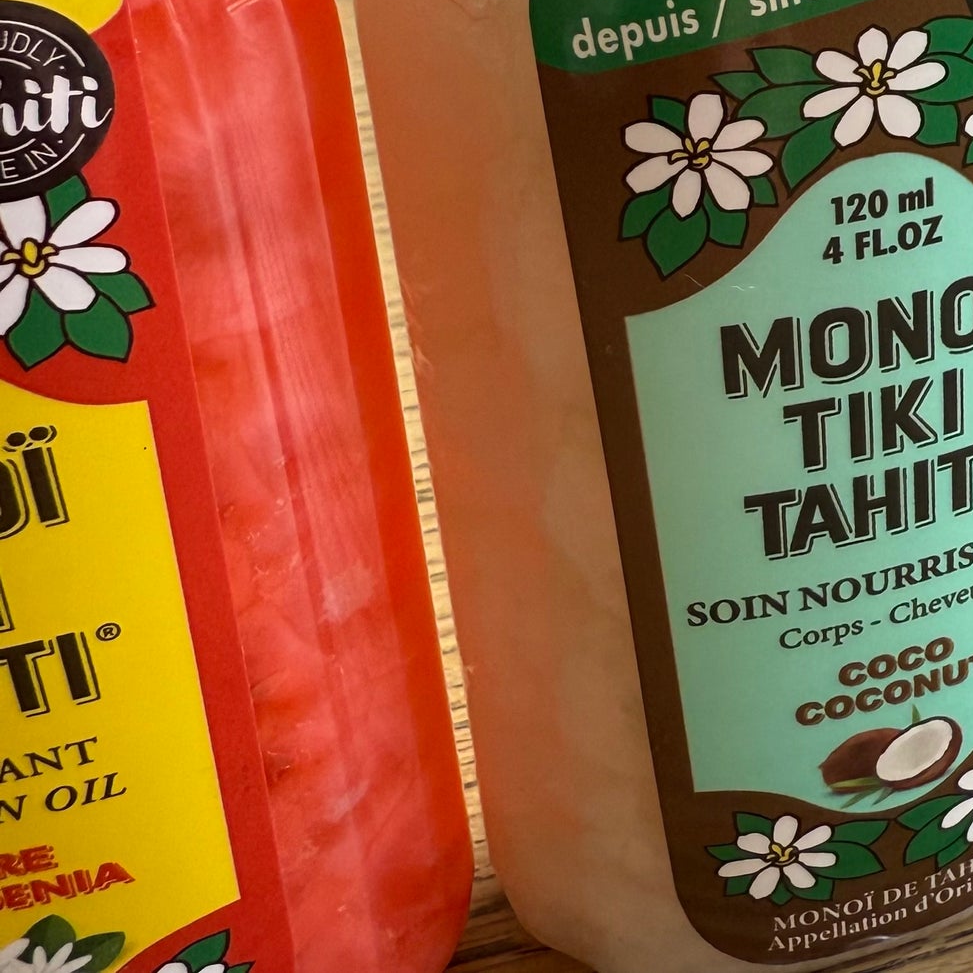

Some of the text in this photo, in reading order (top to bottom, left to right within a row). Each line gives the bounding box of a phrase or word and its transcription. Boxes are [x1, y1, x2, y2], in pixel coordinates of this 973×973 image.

[571, 0, 700, 61] depuis
[830, 176, 935, 225] 120 ml
[822, 215, 943, 265] 4 FL.OZ
[783, 368, 964, 473] TIKI
[686, 590, 790, 628] SOIN
[779, 618, 864, 650] Corps
[837, 635, 955, 687] COCO
[44, 772, 127, 812] OIL
[0, 862, 136, 912] ENIA
[773, 891, 875, 932] MONOÏ
[883, 882, 919, 906] DE
[768, 906, 907, 952] Appellation
